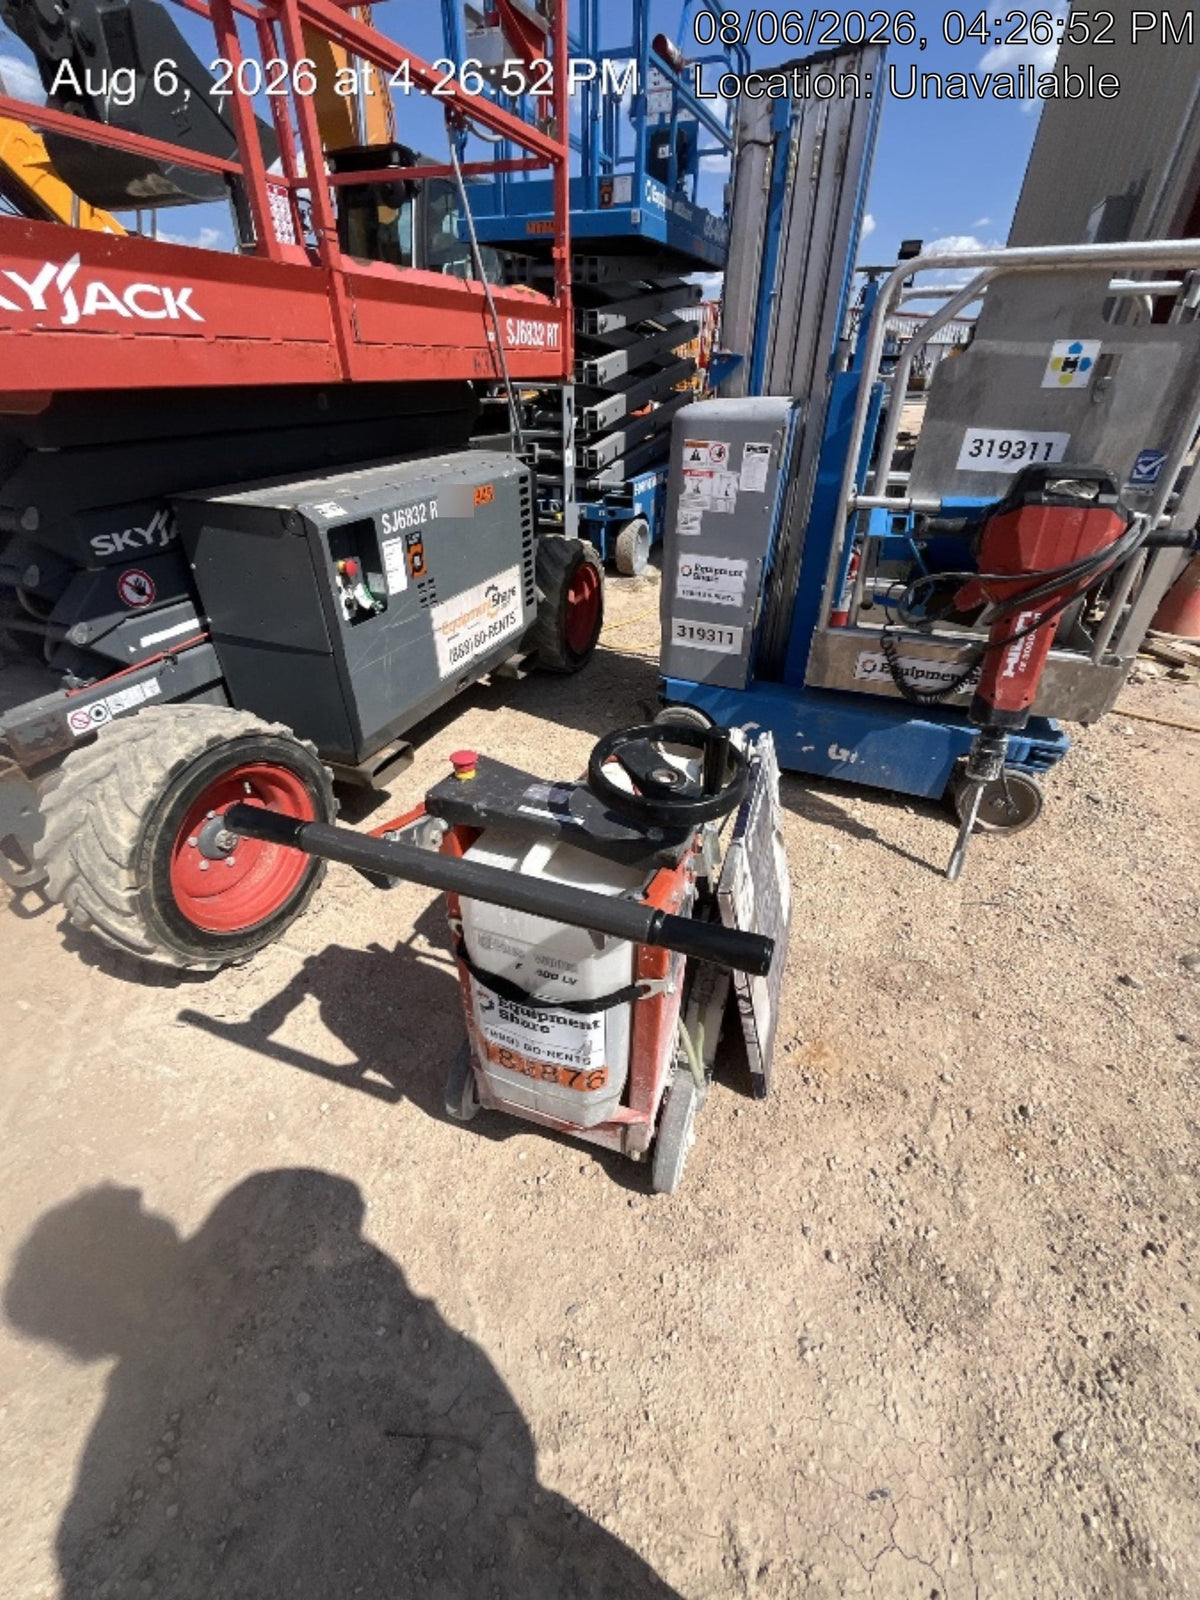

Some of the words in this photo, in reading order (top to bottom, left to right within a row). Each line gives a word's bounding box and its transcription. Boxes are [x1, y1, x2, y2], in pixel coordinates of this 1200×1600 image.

[968, 438, 1054, 461] 319311
[90, 509, 177, 556] SKYJ
[381, 503, 428, 534] SJ6832
[676, 627, 734, 645] 319311
[497, 994, 601, 1031] Equipment
[498, 1008, 551, 1035] Share
